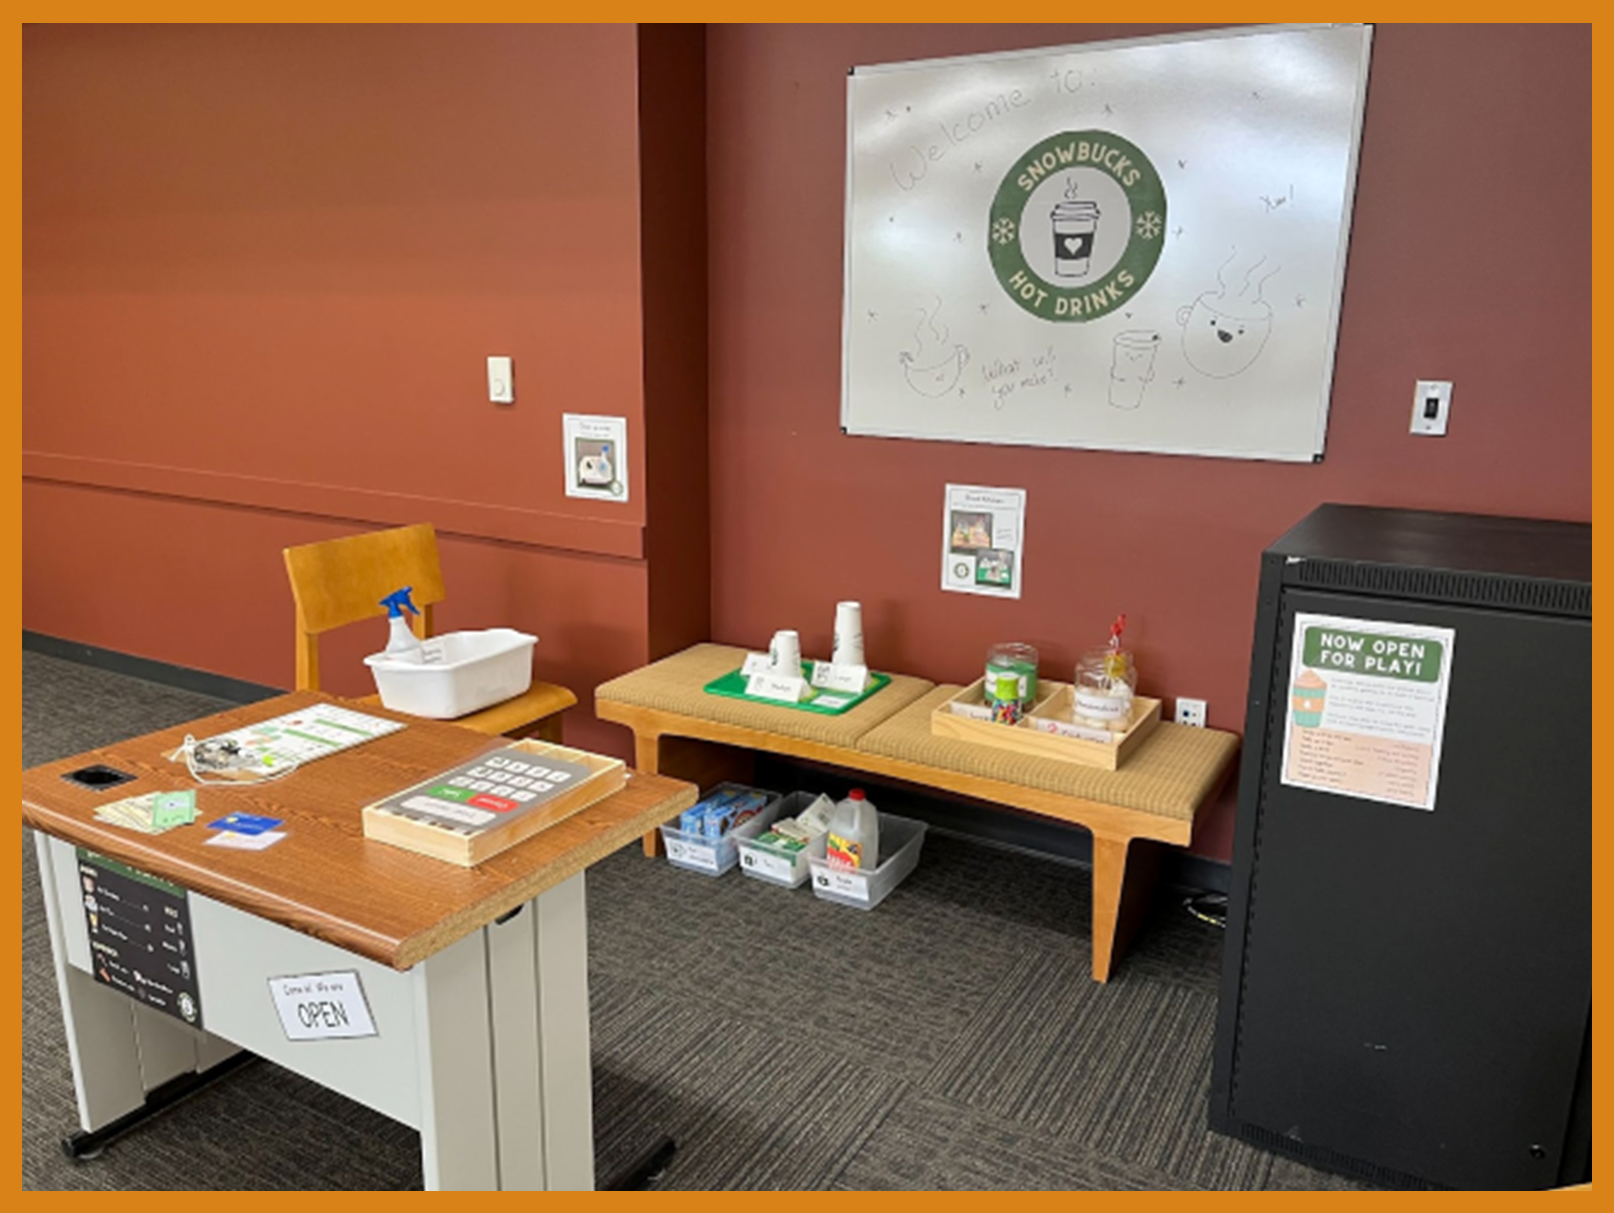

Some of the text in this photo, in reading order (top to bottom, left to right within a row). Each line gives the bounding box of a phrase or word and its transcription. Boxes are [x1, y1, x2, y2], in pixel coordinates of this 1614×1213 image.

[889, 89, 1033, 191] Welcome
[1017, 142, 1141, 191] SNOWBUCKS
[1009, 270, 1135, 316] HOT DRINKS
[1320, 633, 1425, 659] NOW OPEN
[1320, 650, 1422, 676] FOR PLAY!
[297, 1000, 350, 1028] OPEN
